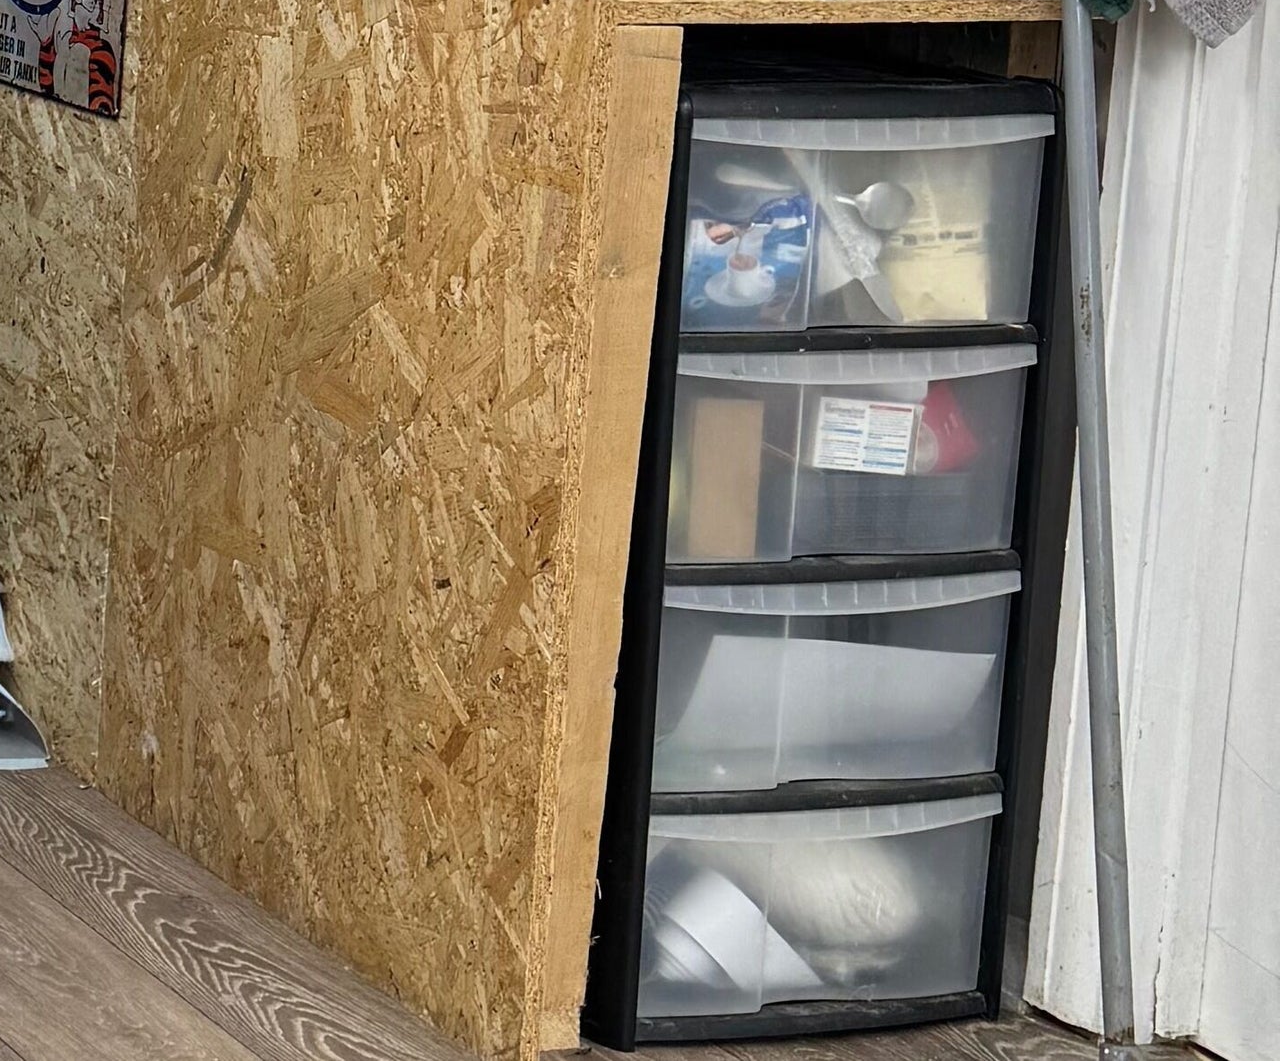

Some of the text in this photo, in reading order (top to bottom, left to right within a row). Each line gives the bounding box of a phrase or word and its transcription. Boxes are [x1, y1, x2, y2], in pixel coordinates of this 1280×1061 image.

[10, 15, 17, 33] A
[16, 39, 26, 58] IN
[13, 59, 38, 84] TANK!
